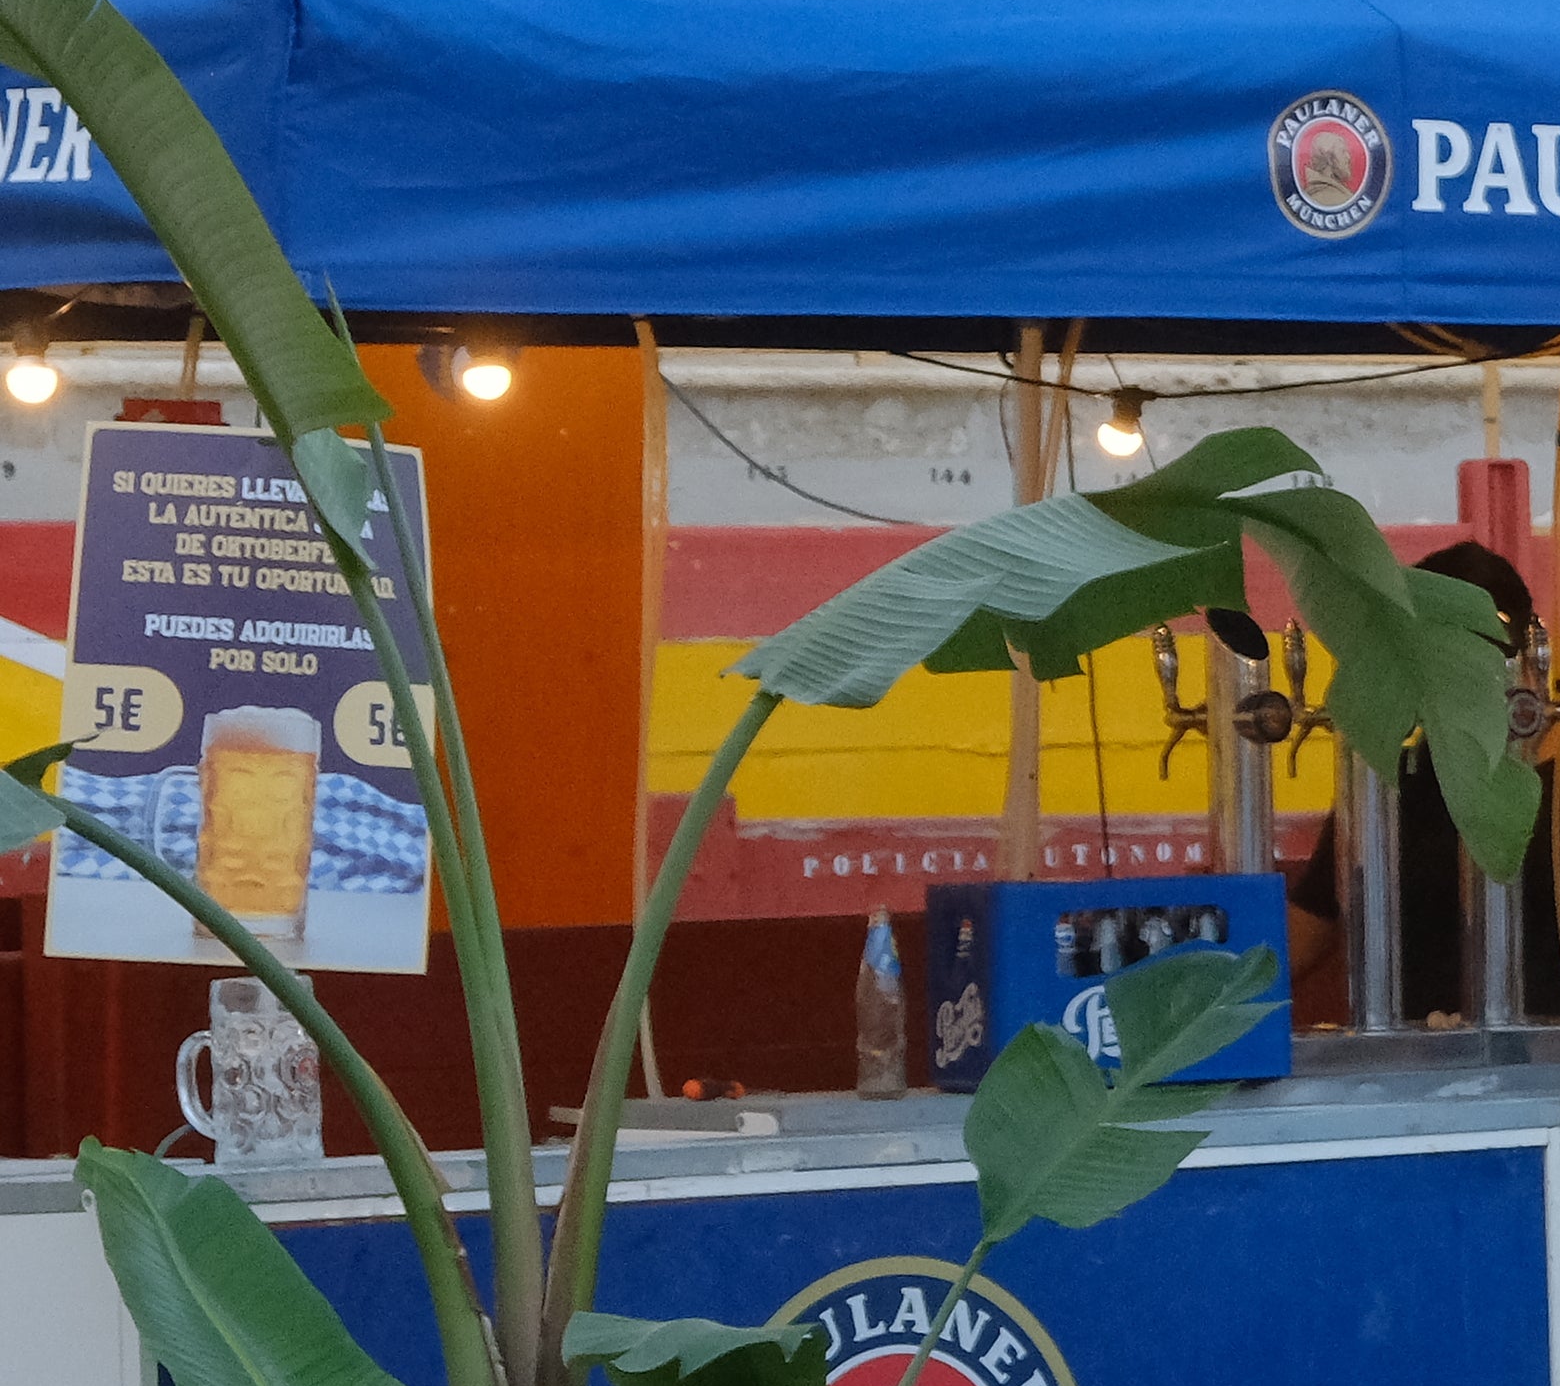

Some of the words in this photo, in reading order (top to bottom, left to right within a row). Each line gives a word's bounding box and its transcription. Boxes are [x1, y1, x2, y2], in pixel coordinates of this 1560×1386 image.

[1276, 98, 1381, 149] PAULANER
[113, 471, 134, 493] SI
[141, 472, 236, 499] QUIERES
[149, 502, 177, 525] LA
[184, 501, 309, 533] AUTÉNTICA
[175, 533, 206, 556] DE
[212, 535, 337, 564] OKTOBERFE
[122, 560, 176, 585] ESTA
[182, 563, 211, 586] ES
[218, 566, 251, 588] TU
[144, 614, 234, 642] PUEDES
[208, 648, 255, 672] POR
[261, 651, 318, 675] SOLO
[802, 850, 989, 878] POLICIA
